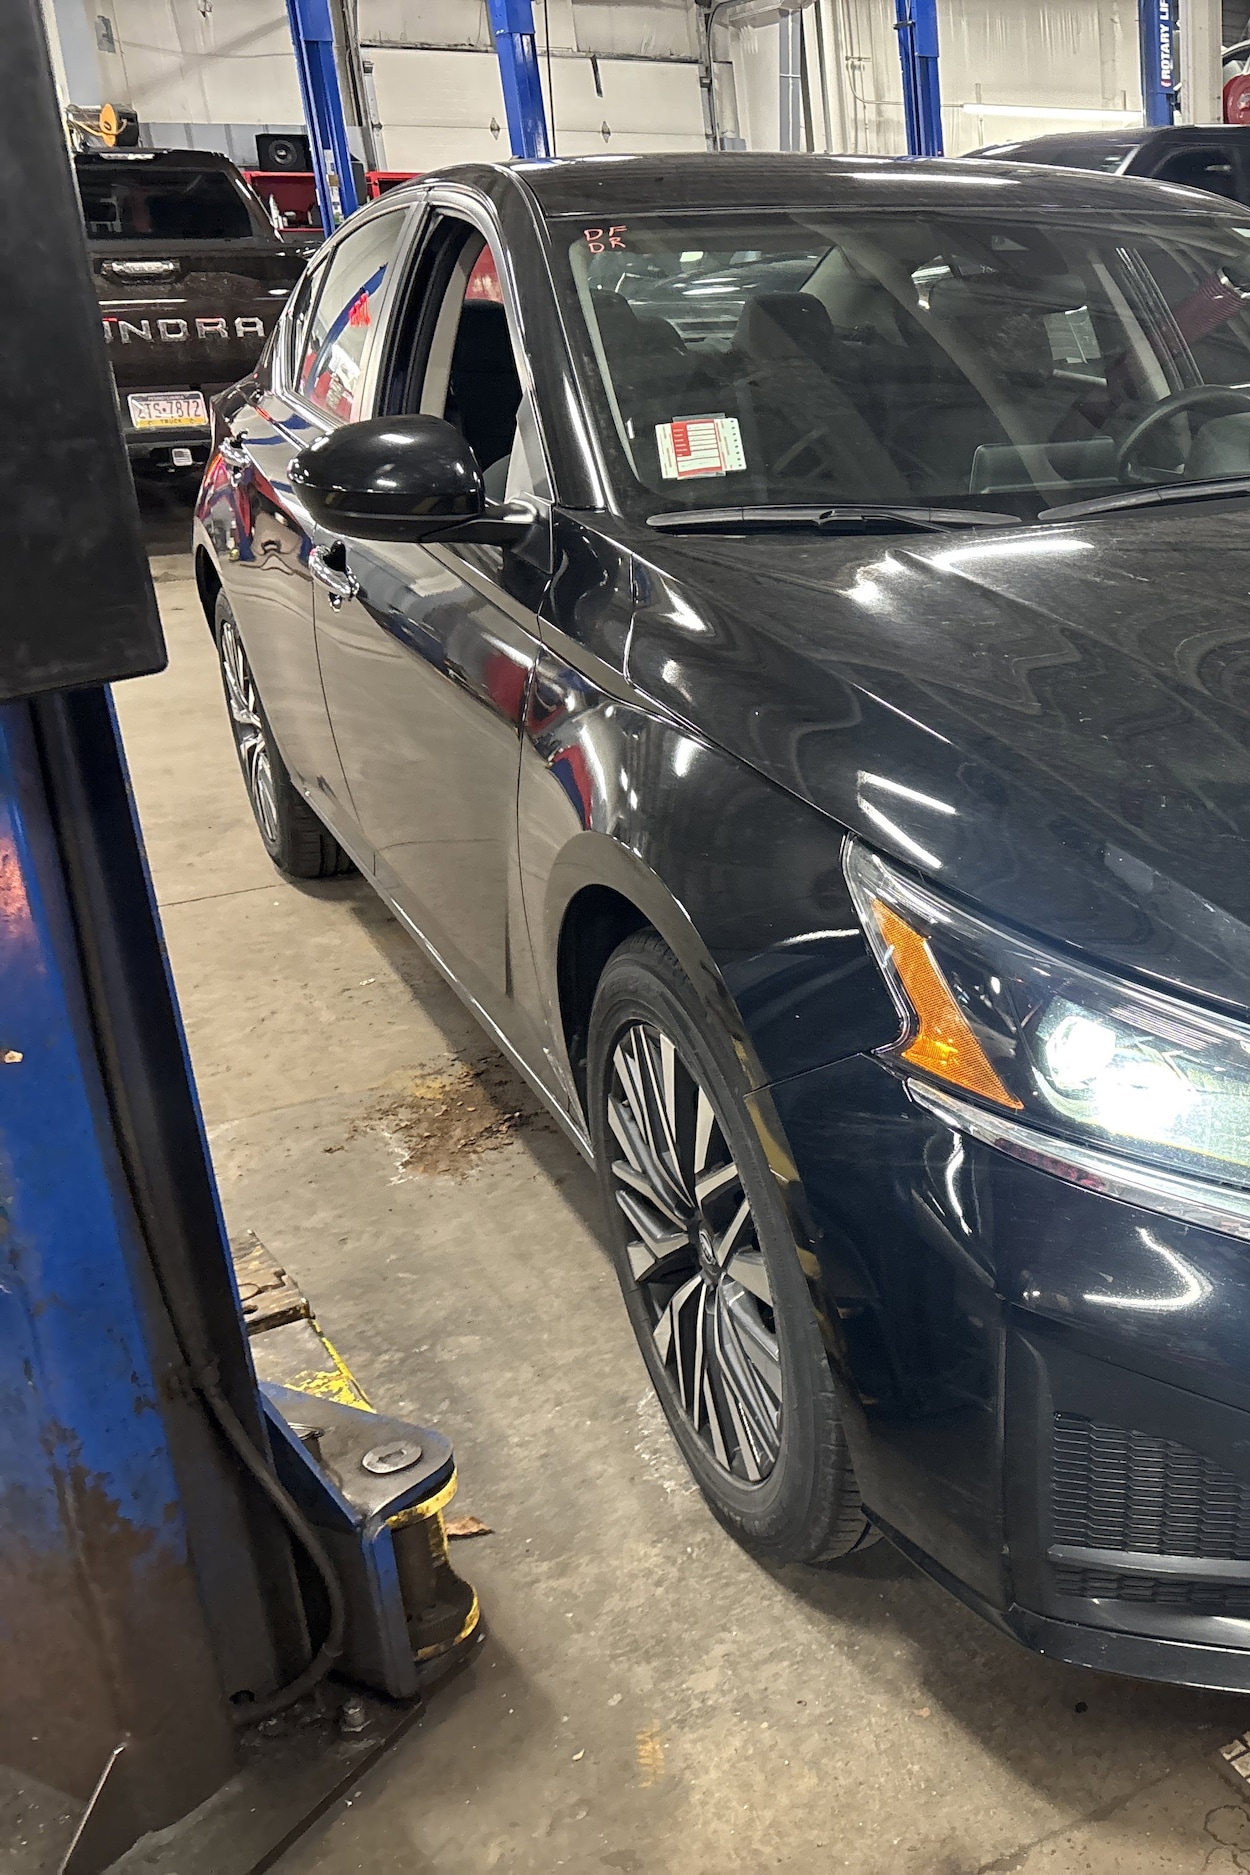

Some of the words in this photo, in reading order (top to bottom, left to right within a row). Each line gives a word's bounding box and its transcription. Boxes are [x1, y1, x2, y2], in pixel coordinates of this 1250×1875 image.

[1160, 24, 1170, 79] ROTARY
[584, 225, 628, 241] DF
[589, 237, 626, 253] DR
